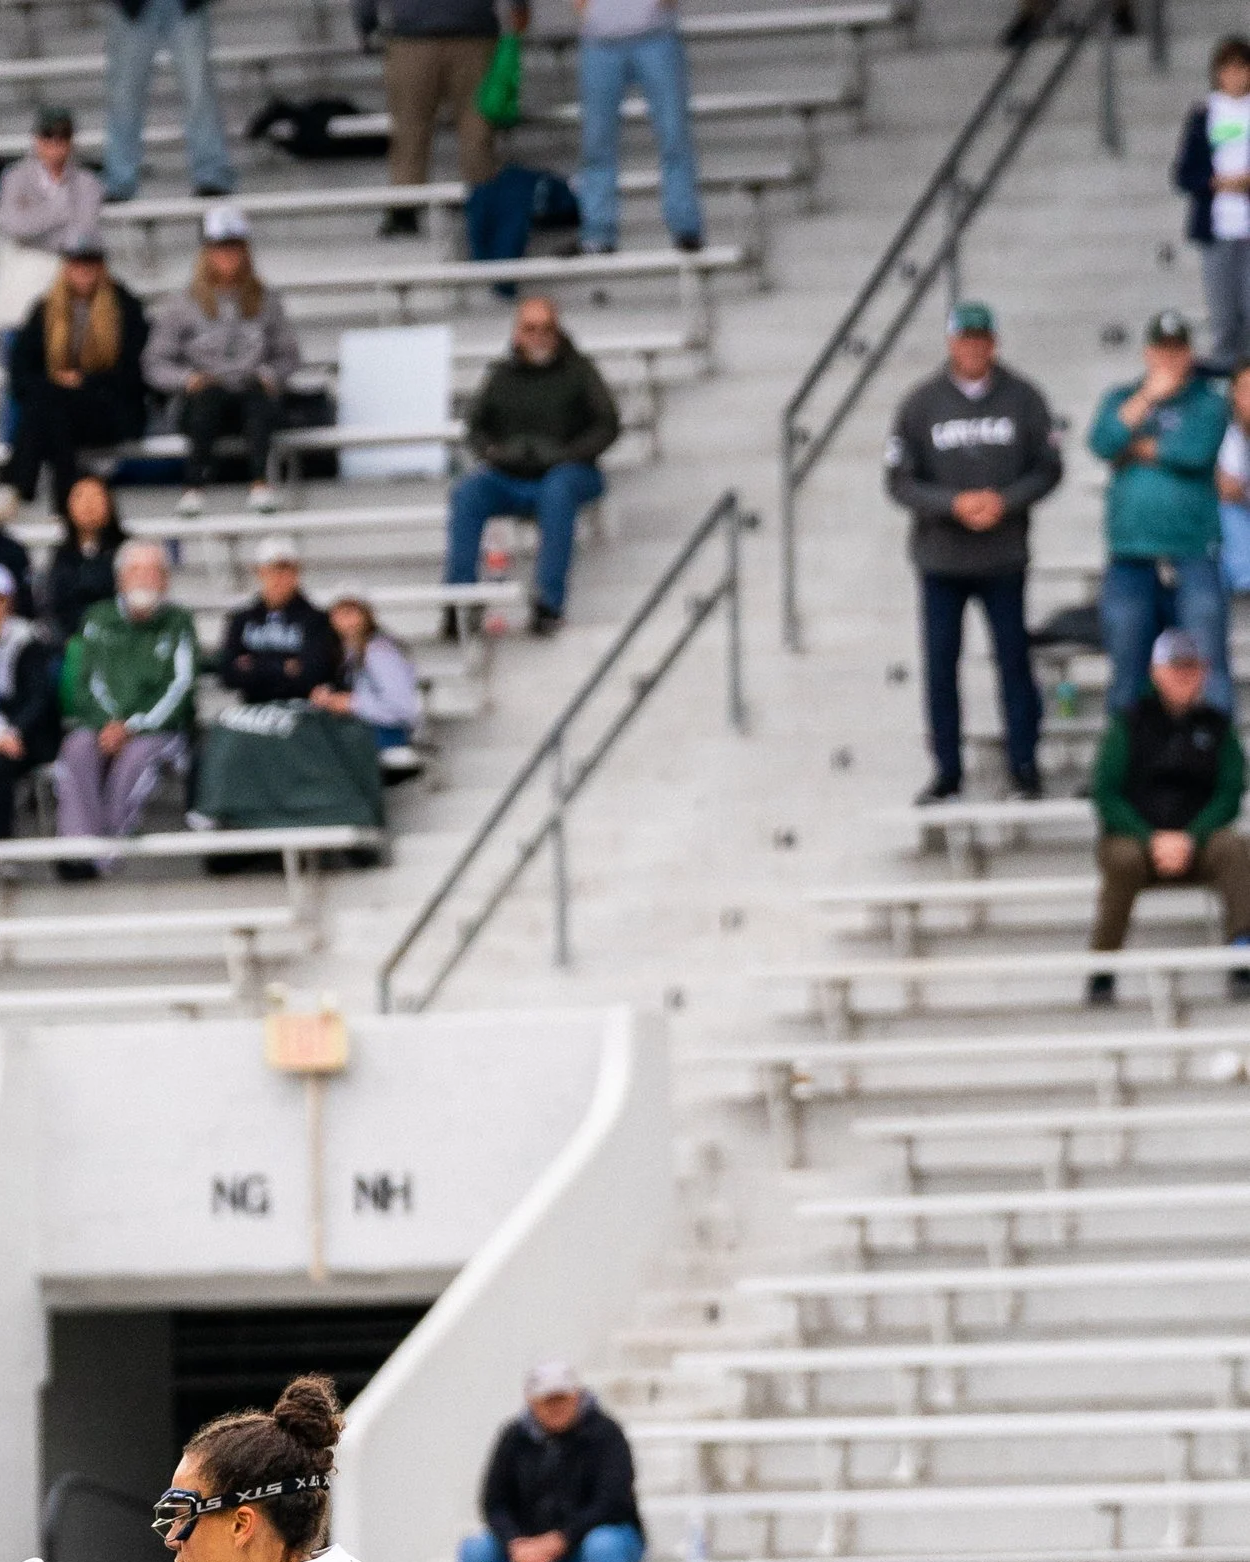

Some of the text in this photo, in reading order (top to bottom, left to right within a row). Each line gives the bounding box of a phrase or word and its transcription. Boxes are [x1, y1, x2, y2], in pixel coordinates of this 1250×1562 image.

[211, 1172, 270, 1216] NG
[354, 1171, 414, 1215] NH
[236, 1482, 283, 1503] STX
